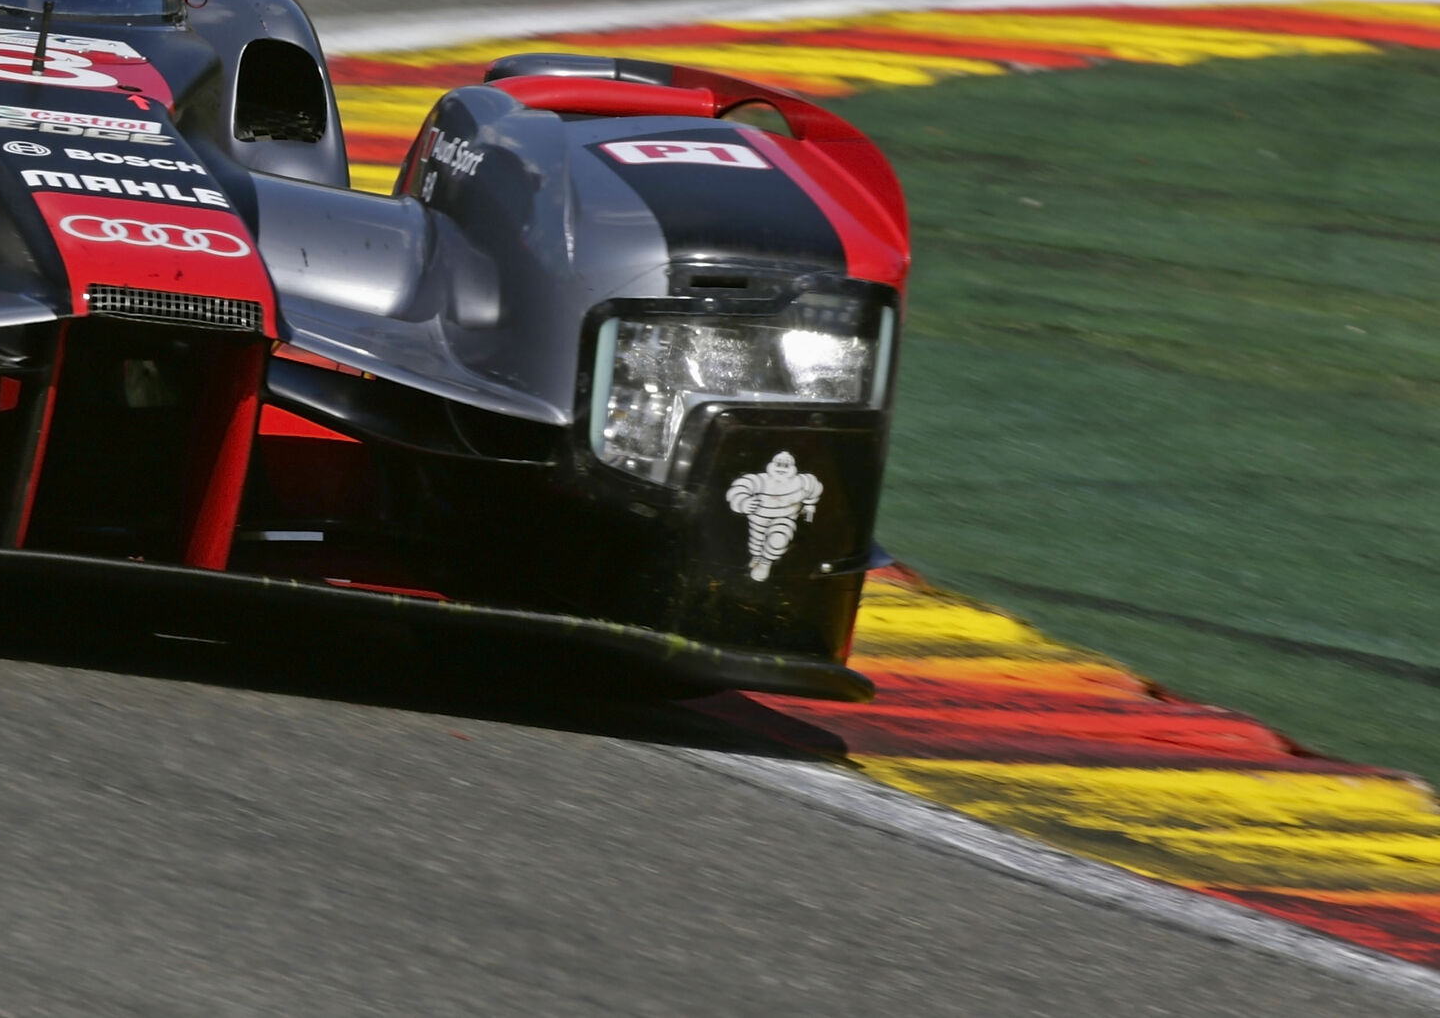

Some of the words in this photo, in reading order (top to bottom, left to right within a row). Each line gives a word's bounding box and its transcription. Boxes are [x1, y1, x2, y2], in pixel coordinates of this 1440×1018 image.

[30, 110, 151, 131] Castrol
[63, 148, 208, 176] BOSCH
[432, 131, 461, 165] Audi
[450, 140, 485, 176] Sport
[634, 144, 740, 163] P1
[20, 169, 231, 209] MAHLE
